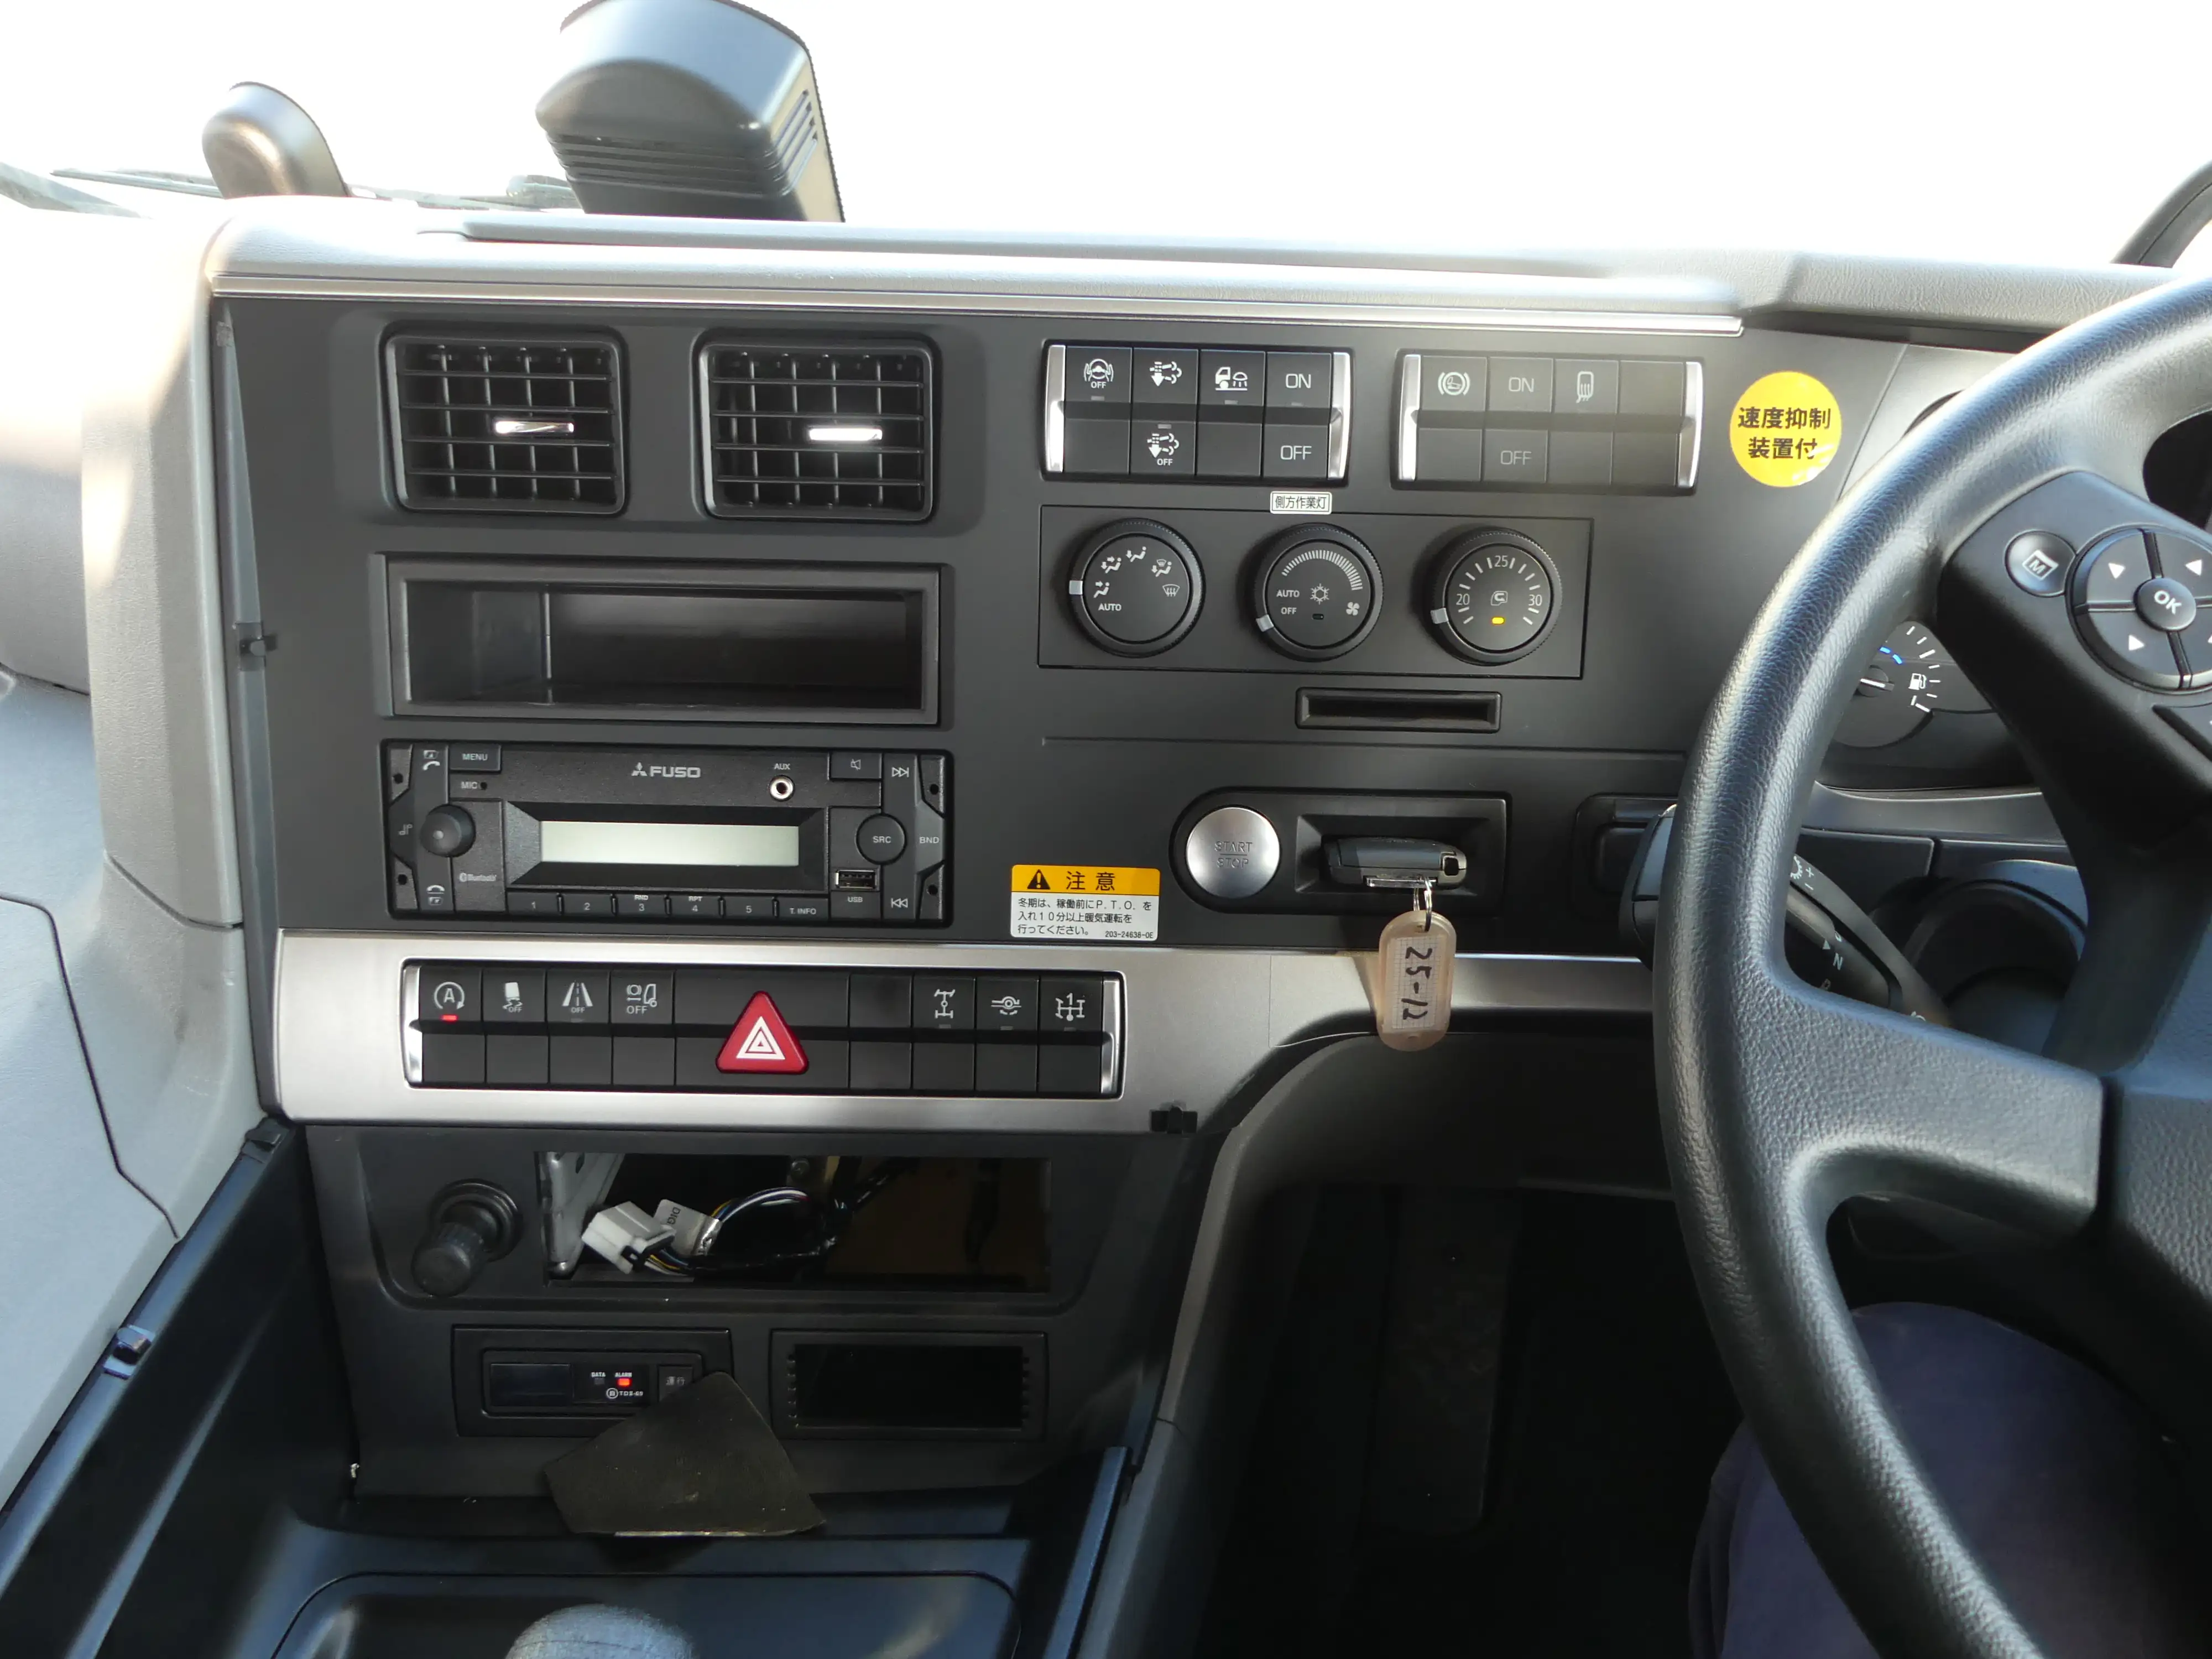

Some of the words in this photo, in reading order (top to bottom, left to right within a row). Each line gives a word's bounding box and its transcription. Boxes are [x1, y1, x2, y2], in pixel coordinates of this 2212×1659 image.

[1091, 380, 1107, 389] OFF
[1286, 374, 1311, 389] ON
[1508, 377, 1535, 392] ON
[1738, 406, 1832, 430] 速度抑制
[1280, 445, 1311, 460] OFF
[1747, 437, 1819, 460] 装置付
[1157, 458, 1173, 466] OFF
[1500, 450, 1532, 465] OFF
[1275, 495, 1327, 509] 側方作業灯
[1494, 556, 1508, 567] 25
[1276, 589, 1300, 598] AUTO
[1456, 594, 1470, 606] 20
[1528, 594, 1542, 606] 30
[2153, 589, 2182, 614] OK
[1281, 607, 1297, 615] OFF
[650, 765, 701, 778] FUSO
[1214, 841, 1253, 853] START
[1217, 858, 1249, 868] STOP
[746, 905, 752, 914] 5
[1018, 925, 1088, 936] 行ってください。
[1833, 952, 1843, 971] N
[626, 1005, 648, 1014] OFF
